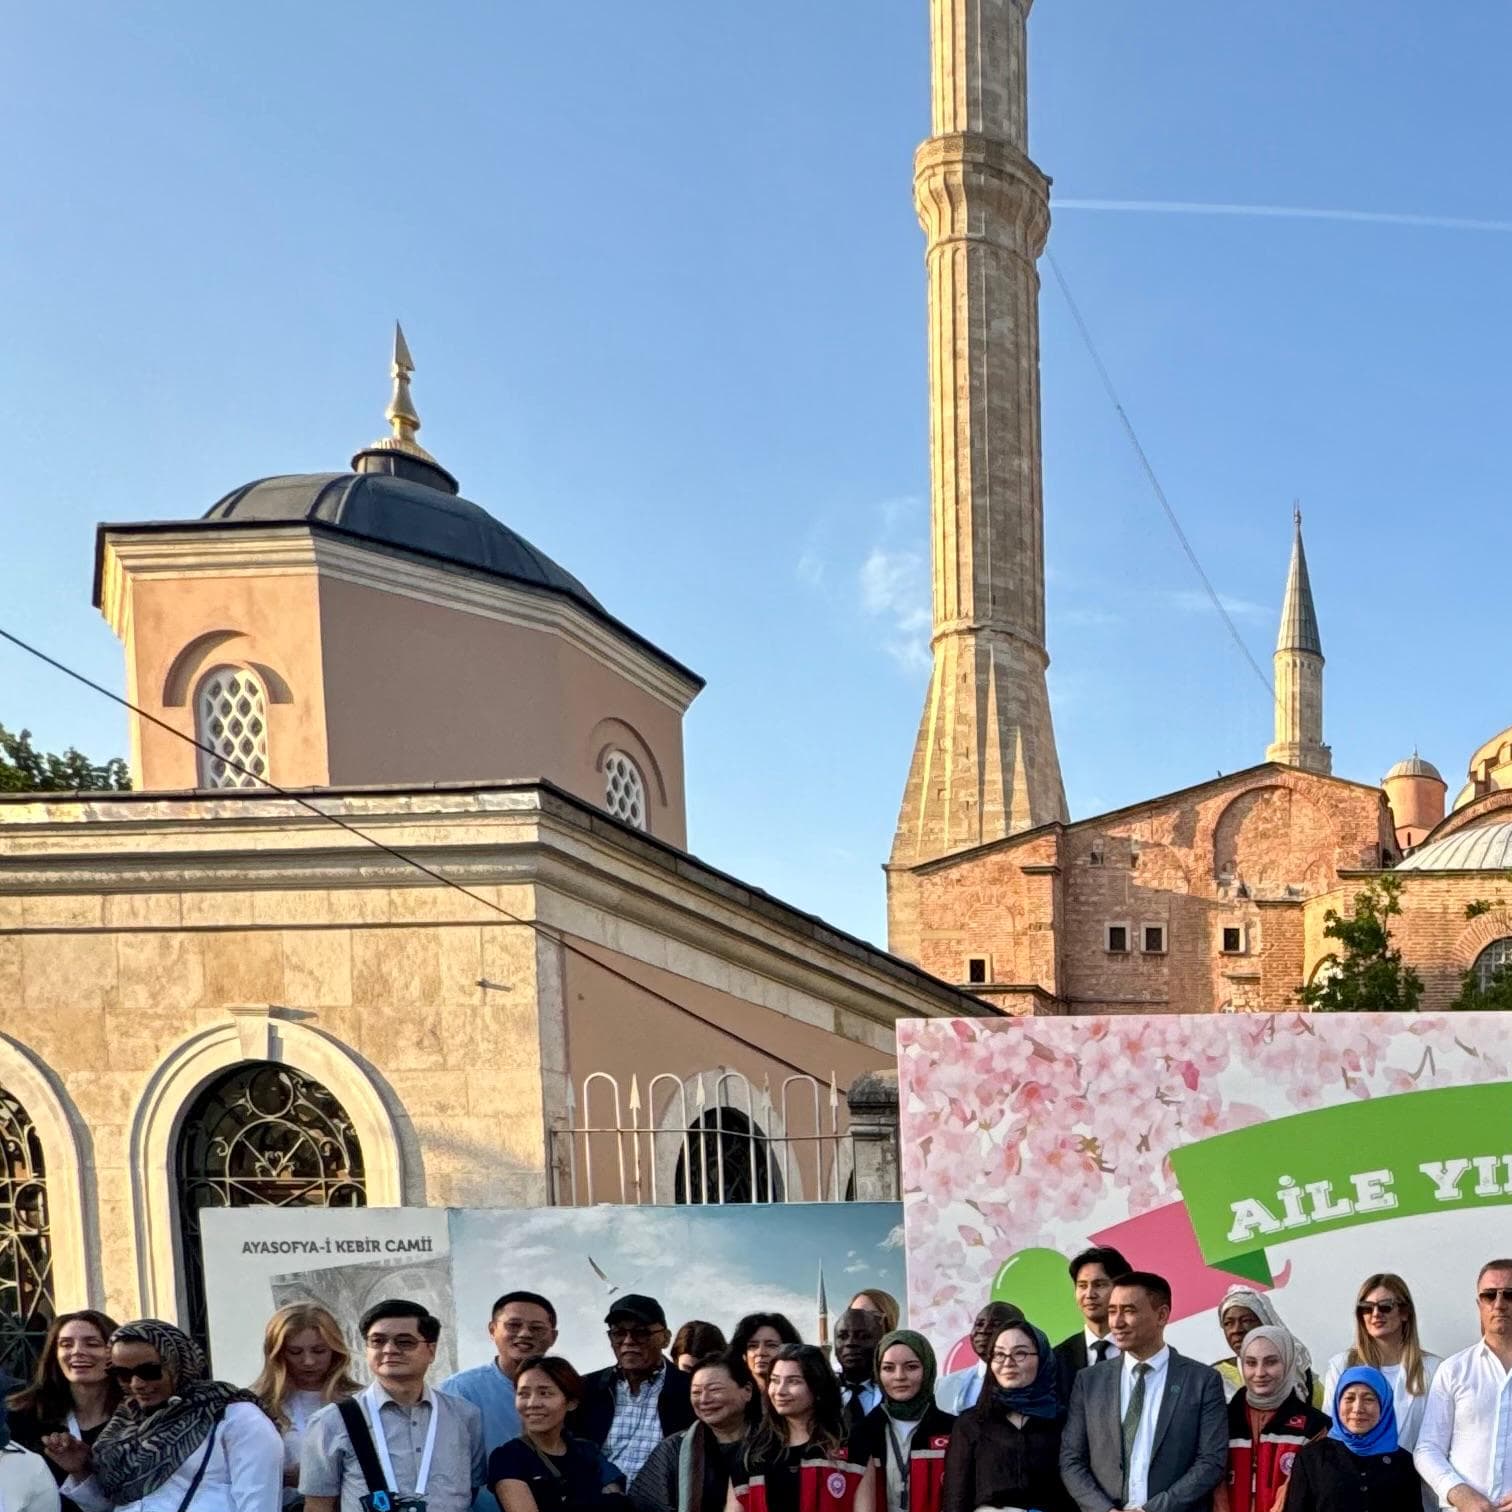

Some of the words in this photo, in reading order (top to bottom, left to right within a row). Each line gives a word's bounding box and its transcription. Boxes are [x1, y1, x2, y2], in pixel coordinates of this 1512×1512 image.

[1227, 1169, 1399, 1242] AİLE
[242, 1237, 332, 1254] AYASOFYA-İ
[335, 1236, 381, 1253] KEBİR
[385, 1236, 432, 1252] CAMİİ
